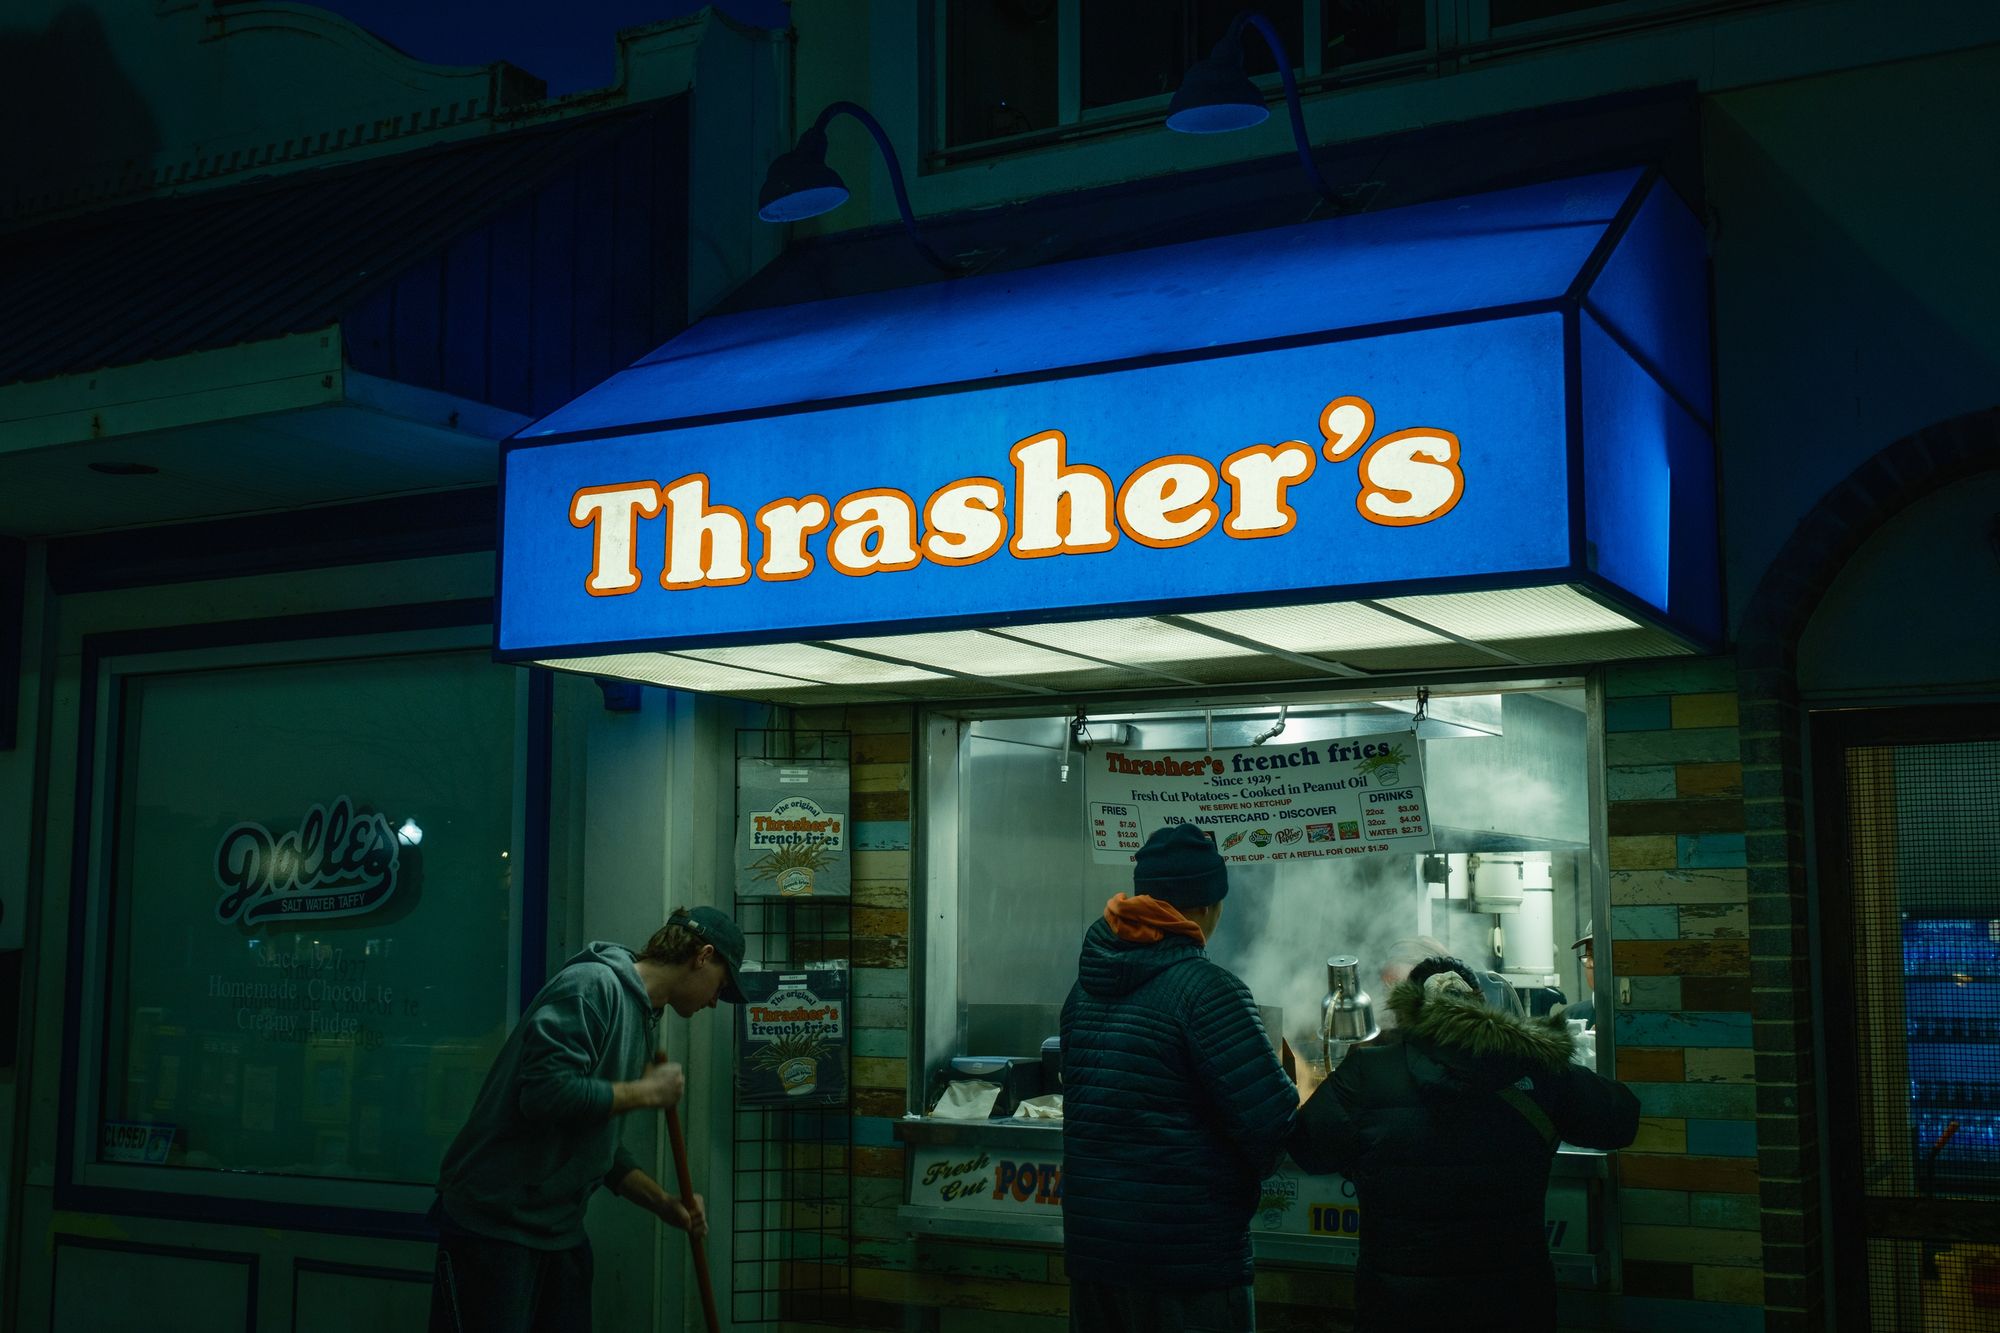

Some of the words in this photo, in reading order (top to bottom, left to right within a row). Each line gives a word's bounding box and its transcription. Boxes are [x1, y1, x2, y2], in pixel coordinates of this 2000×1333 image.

[568, 395, 1466, 598] Thrasher's
[1106, 752, 1225, 776] Thrasher's
[1232, 747, 1320, 772] french
[1327, 740, 1390, 763] fries
[1131, 789, 1159, 801] Fresh
[1160, 791, 1180, 802] Cut
[1181, 790, 1230, 802] Potatoes
[1240, 784, 1286, 799] Cooked
[1288, 783, 1301, 795] in
[1302, 779, 1346, 793] Peanut
[1348, 775, 1368, 789] Oil
[1211, 776, 1243, 787] Since
[1247, 774, 1272, 787] 1929
[1199, 804, 1212, 812] WE
[1213, 802, 1239, 811] SERVE
[1240, 801, 1252, 809] NO
[1254, 798, 1292, 808] KETCHUP
[1369, 789, 1414, 803] DRINKS
[775, 803, 790, 817] The
[790, 800, 821, 818] original
[1101, 805, 1128, 816] FRIES
[1163, 816, 1187, 825] VISA
[1195, 812, 1270, 825] MASTERCARD
[1279, 805, 1337, 820] DISCOVER
[754, 815, 841, 833] Thrasher's
[1094, 819, 1105, 827] SM
[1369, 827, 1398, 837] WATER
[754, 832, 802, 845] french
[806, 832, 839, 846] fries
[1272, 852, 1288, 860] GET
[1289, 851, 1296, 859] A
[1296, 848, 1325, 858] REFILL
[1326, 847, 1343, 856] FOR
[1344, 845, 1367, 855] ONLY
[281, 899, 302, 913] SALT
[305, 897, 336, 912] WATER
[337, 893, 367, 909] TAFFY
[256, 945, 300, 969] Since
[309, 947, 344, 970] 1927
[208, 975, 297, 1000] Homemade
[771, 993, 786, 1006] The
[786, 990, 817, 1006] original
[236, 1007, 299, 1036] Creamy
[308, 1010, 359, 1034] Fudge
[750, 1005, 838, 1022] Thrasher's
[752, 1022, 801, 1035] french
[804, 1021, 838, 1034] fries
[104, 1126, 147, 1149] CLOSED
[922, 1152, 990, 1186] Fresh
[940, 1177, 988, 1202] Cut
